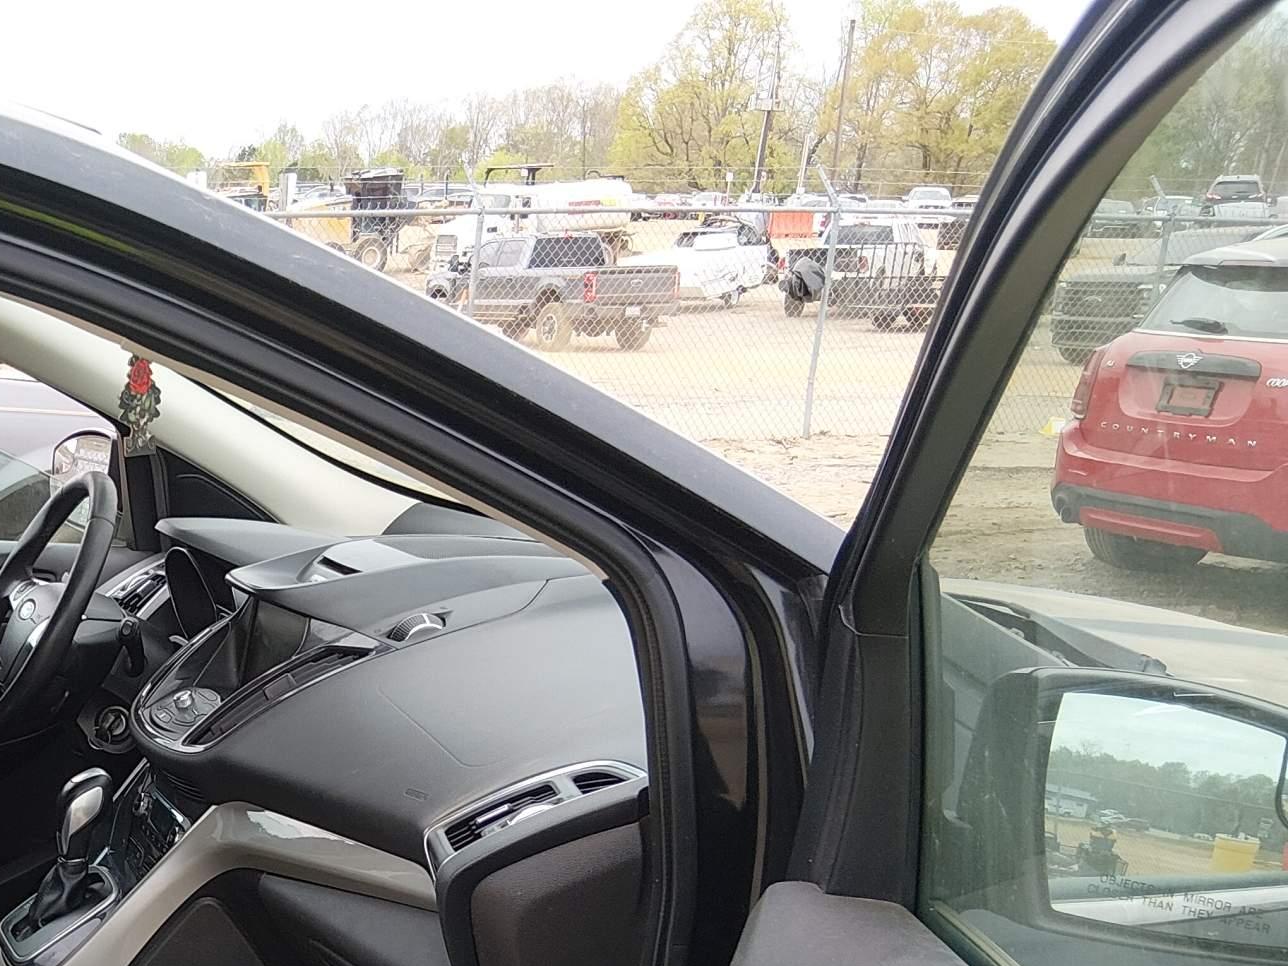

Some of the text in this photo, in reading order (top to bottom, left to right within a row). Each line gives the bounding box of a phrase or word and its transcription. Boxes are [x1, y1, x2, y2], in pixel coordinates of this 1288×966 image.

[1099, 421, 1257, 447] COUNTRYMAN
[1142, 896, 1174, 912] THAN
[1182, 905, 1214, 920] THEY
[1183, 892, 1232, 912] MIRROR
